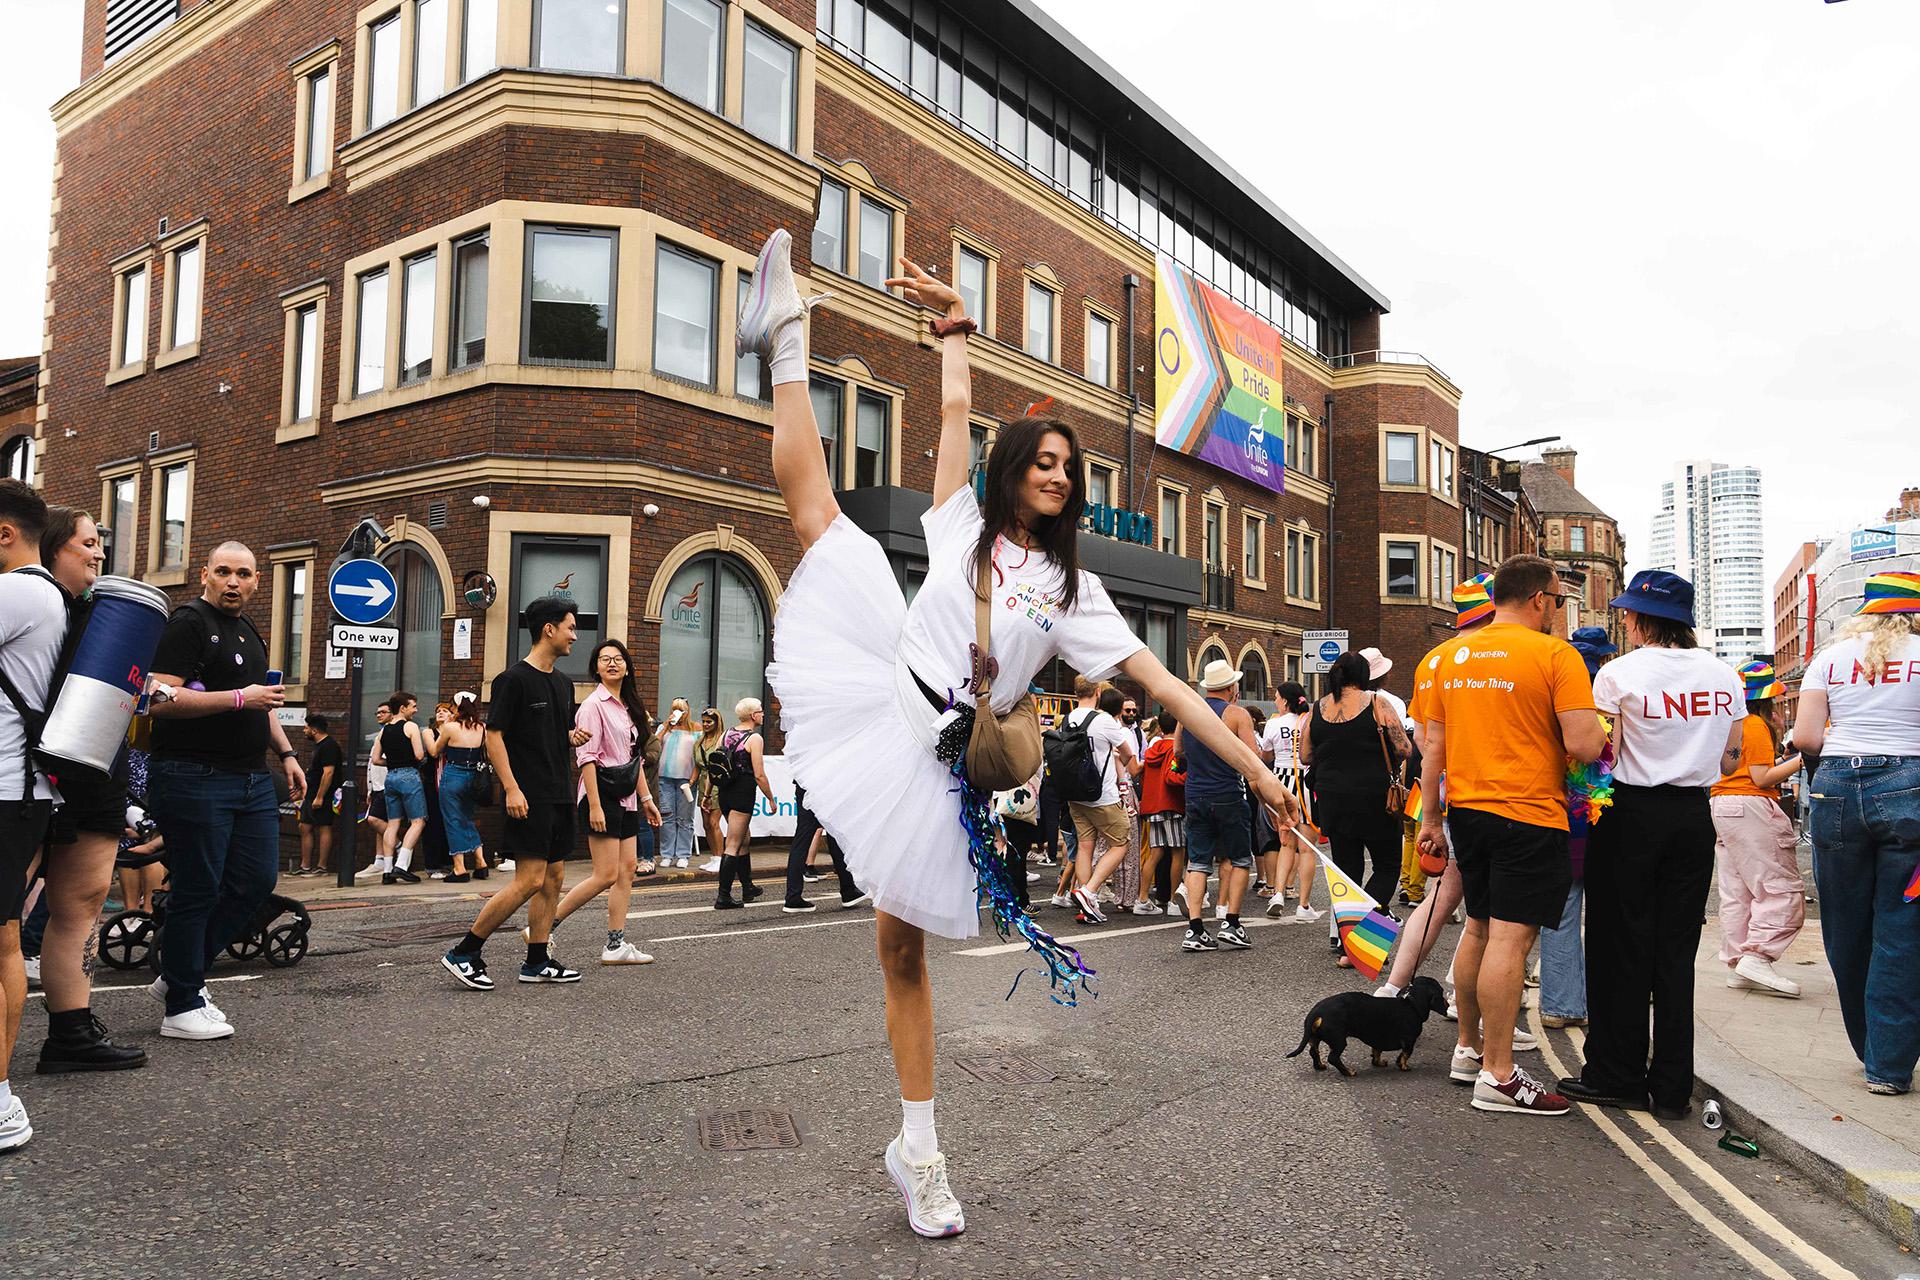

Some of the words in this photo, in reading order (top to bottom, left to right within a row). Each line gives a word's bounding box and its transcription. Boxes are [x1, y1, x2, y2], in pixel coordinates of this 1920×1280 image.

[1235, 333, 1263, 369] Unite
[1265, 352, 1275, 377] in
[1243, 367, 1270, 401] Pride
[1243, 439, 1268, 467] Unite
[1852, 530, 1893, 547] CLEGG
[1015, 581, 1036, 594] YOU
[671, 608, 701, 623] Unite
[1006, 596, 1053, 633] QUEEN
[338, 630, 365, 642] One
[369, 634, 395, 646] way
[1471, 650, 1509, 659] NORTHERN
[1453, 678, 1463, 689] Do
[1466, 678, 1487, 689] Your
[1488, 678, 1515, 692] Thing
[1643, 689, 1733, 722] LNER
[1280, 726, 1300, 739] Be
